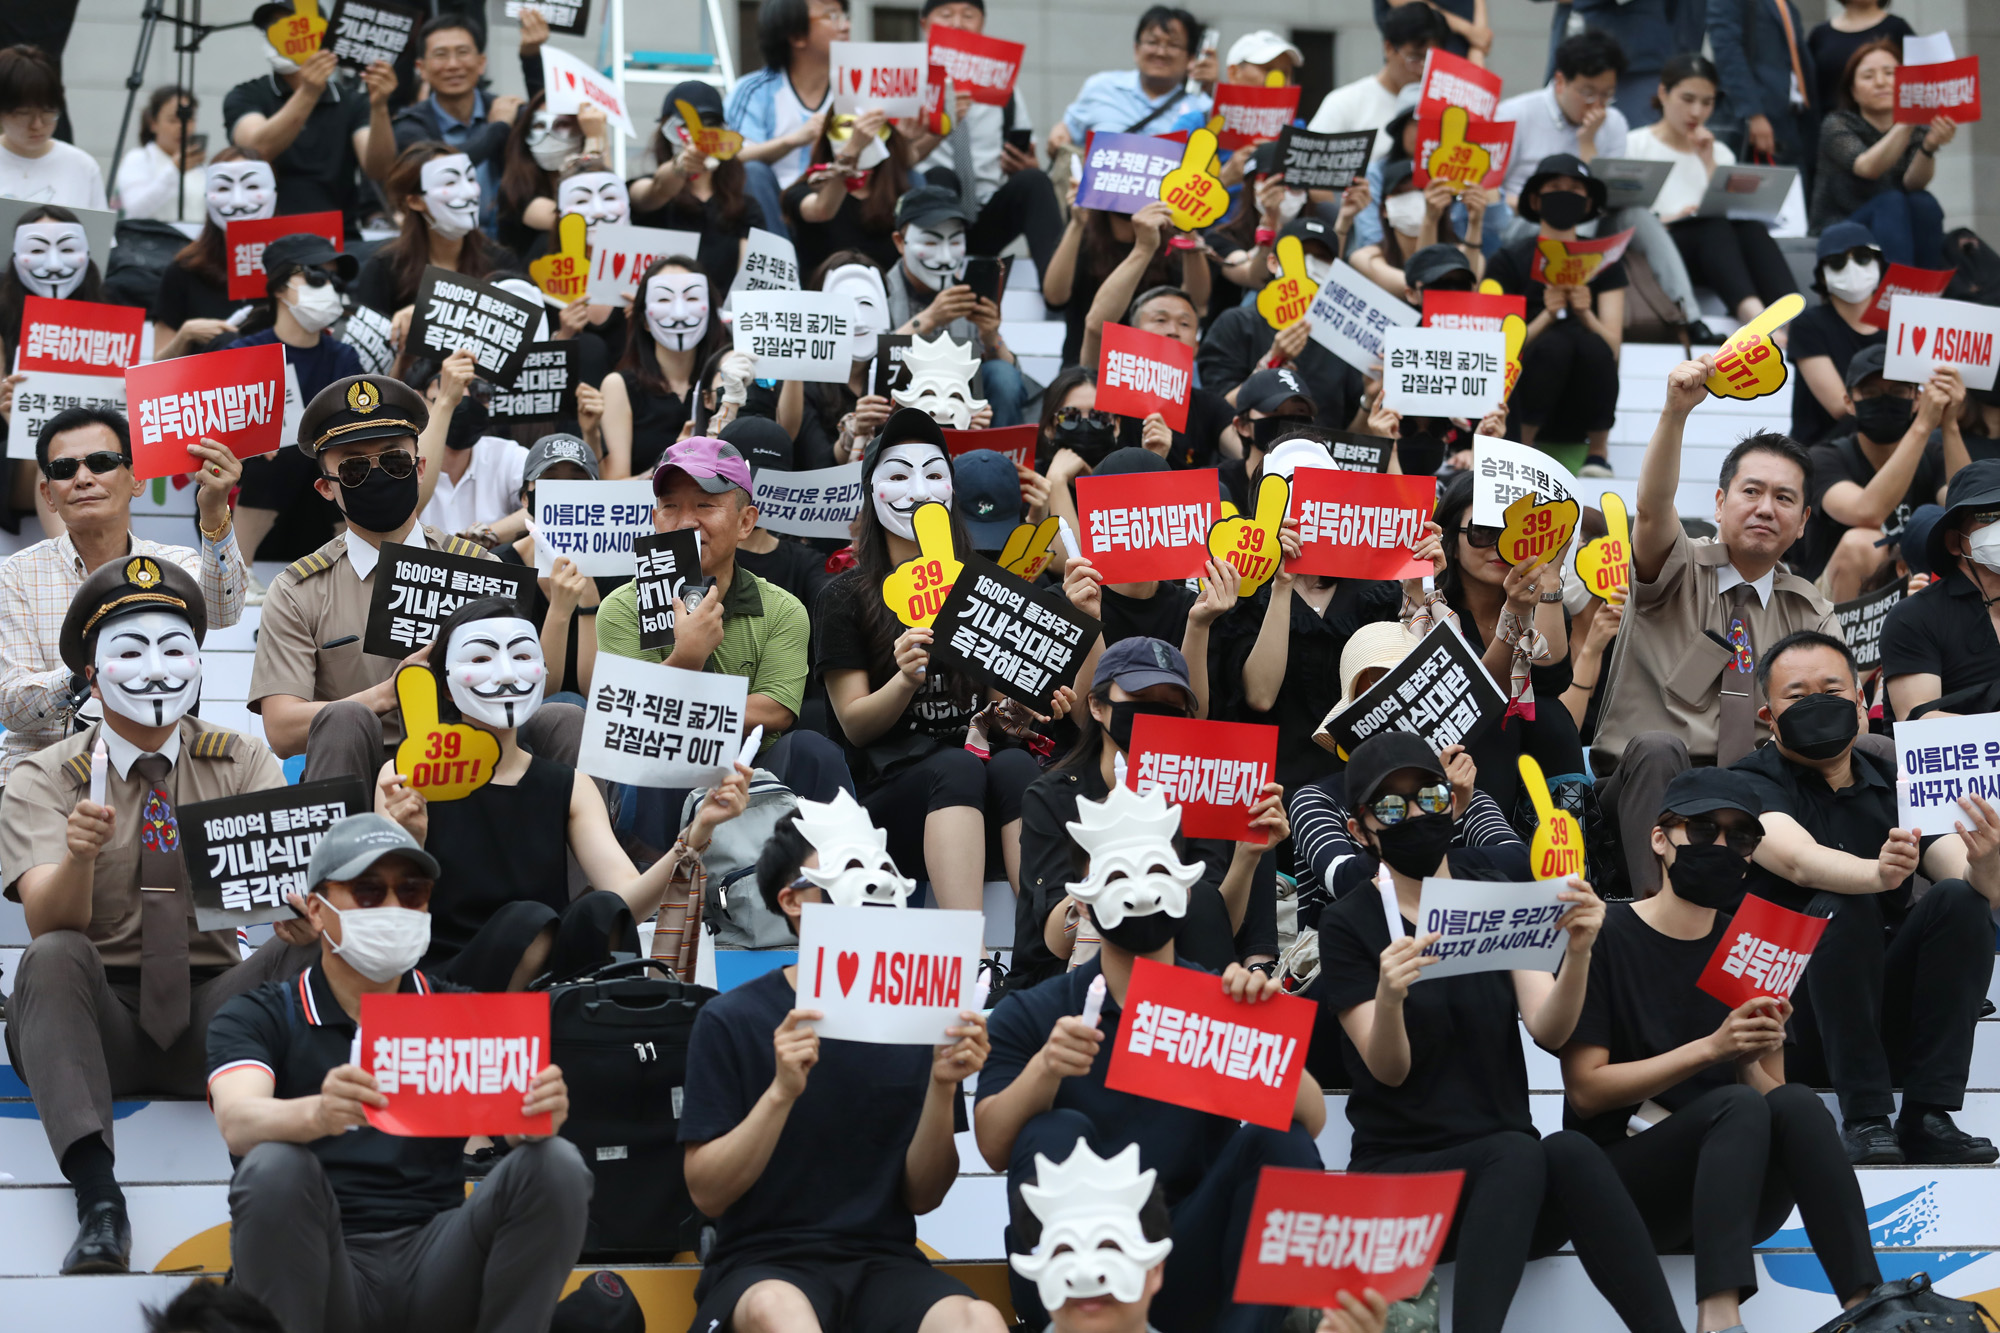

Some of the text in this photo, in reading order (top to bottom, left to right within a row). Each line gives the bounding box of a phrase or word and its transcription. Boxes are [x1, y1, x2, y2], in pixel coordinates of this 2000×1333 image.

[288, 17, 310, 37] 39
[838, 66, 919, 98] I ASIANA
[1448, 145, 1473, 165] 39
[1185, 174, 1213, 198] 39
[1166, 187, 1213, 222] OUT!
[551, 256, 575, 277] 39
[598, 249, 606, 281] I
[545, 275, 588, 296] OUT!
[1277, 279, 1299, 298] 39
[433, 279, 530, 329] 1600억 돌려주고
[424, 299, 524, 353] 기내식대란
[740, 311, 847, 336] 승객·직원 굶기는
[27, 321, 137, 369] 침묵하지말자!
[752, 336, 837, 361] 갑질삼구 OUT
[1390, 348, 1498, 373] 승객·직원 굶기는
[1736, 333, 1771, 367] 39
[1896, 322, 1994, 368] I ASIANA
[1105, 349, 1188, 406] 침묵하지말자!
[1714, 342, 1761, 392] OUT!
[1401, 373, 1457, 396] 갑질삼구
[1462, 376, 1488, 397] OUT
[138, 379, 276, 446] 침묵하지말자!
[1481, 457, 1550, 492] 승객·직원
[757, 482, 863, 505] 아름다운 우리가
[543, 503, 654, 526] 아름다운 우리가
[1089, 501, 1213, 553] 침묵하지말자!
[1299, 499, 1427, 550] 침묵하지말자!
[1522, 509, 1552, 536] 39
[1236, 524, 1266, 553] 39
[1513, 523, 1566, 561] OUT!
[1599, 539, 1622, 565] 39
[395, 560, 519, 601] 1600억 돌려주고
[911, 560, 944, 592] 39
[973, 574, 1085, 646] 1600억 돌려주고
[956, 594, 1073, 675] 기내식대란
[950, 625, 1052, 697] 즉각해결!
[596, 683, 738, 735] 승객·직원 굶기는
[1350, 644, 1453, 740] 1600억 돌려주고
[424, 731, 461, 761] 39
[604, 721, 725, 767] 갑질삼구 OUT
[1905, 742, 1980, 776] 아름다운
[412, 758, 481, 789] OUT!
[1136, 750, 1268, 808] 침묵하지말자!
[1909, 779, 1963, 809] 바꾸자
[203, 801, 347, 842] 1600억 돌려주고
[1550, 816, 1568, 847] 39
[1541, 848, 1580, 878] OUT!
[1427, 904, 1566, 936] 아름다운 우리가
[1479, 928, 1561, 959] 아시아나!
[813, 946, 962, 1009] I ASIANA
[1127, 1000, 1298, 1088] 침묵하지말자!
[371, 1035, 541, 1096] 침묵하지말자!
[1258, 1207, 1443, 1275] 침묵하지말자!
